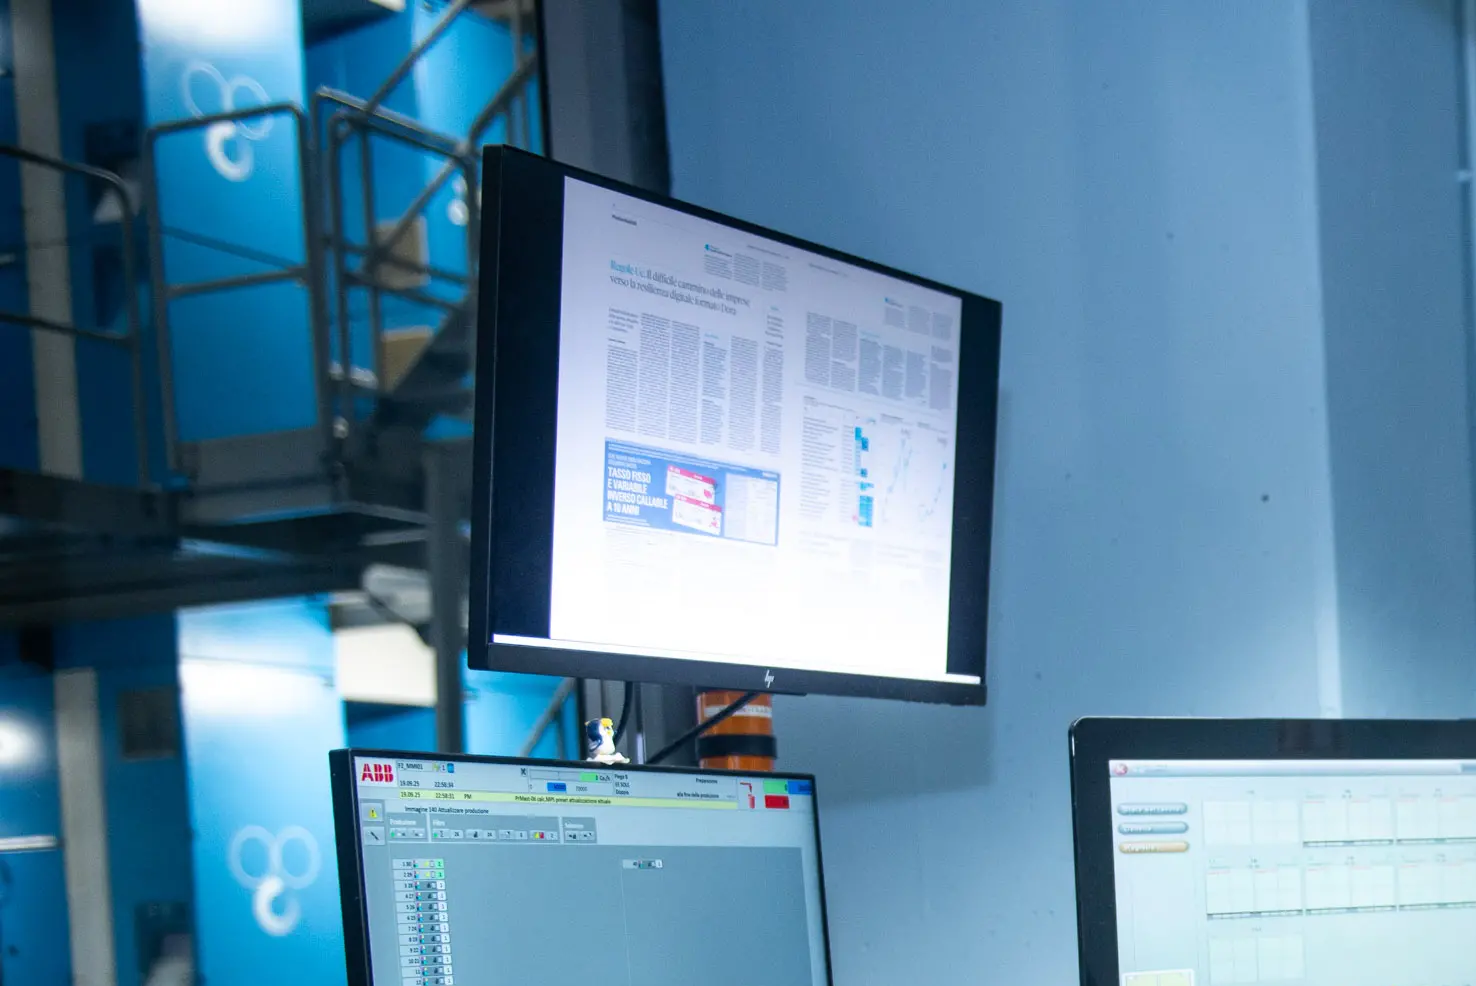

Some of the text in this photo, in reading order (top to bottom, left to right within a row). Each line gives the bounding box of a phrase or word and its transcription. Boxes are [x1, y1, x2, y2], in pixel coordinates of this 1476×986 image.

[653, 272, 677, 287] difficile
[610, 275, 629, 287] verso
[637, 282, 668, 297] resilienza
[670, 289, 693, 304] digitale
[608, 466, 651, 484] TASSO FISSO
[608, 478, 648, 494] E VARIABILE
[608, 490, 636, 504] INVERSO
[607, 501, 612, 512] A
[622, 504, 640, 515] ANNI
[765, 670, 774, 688] hp
[362, 763, 394, 782] ABB
